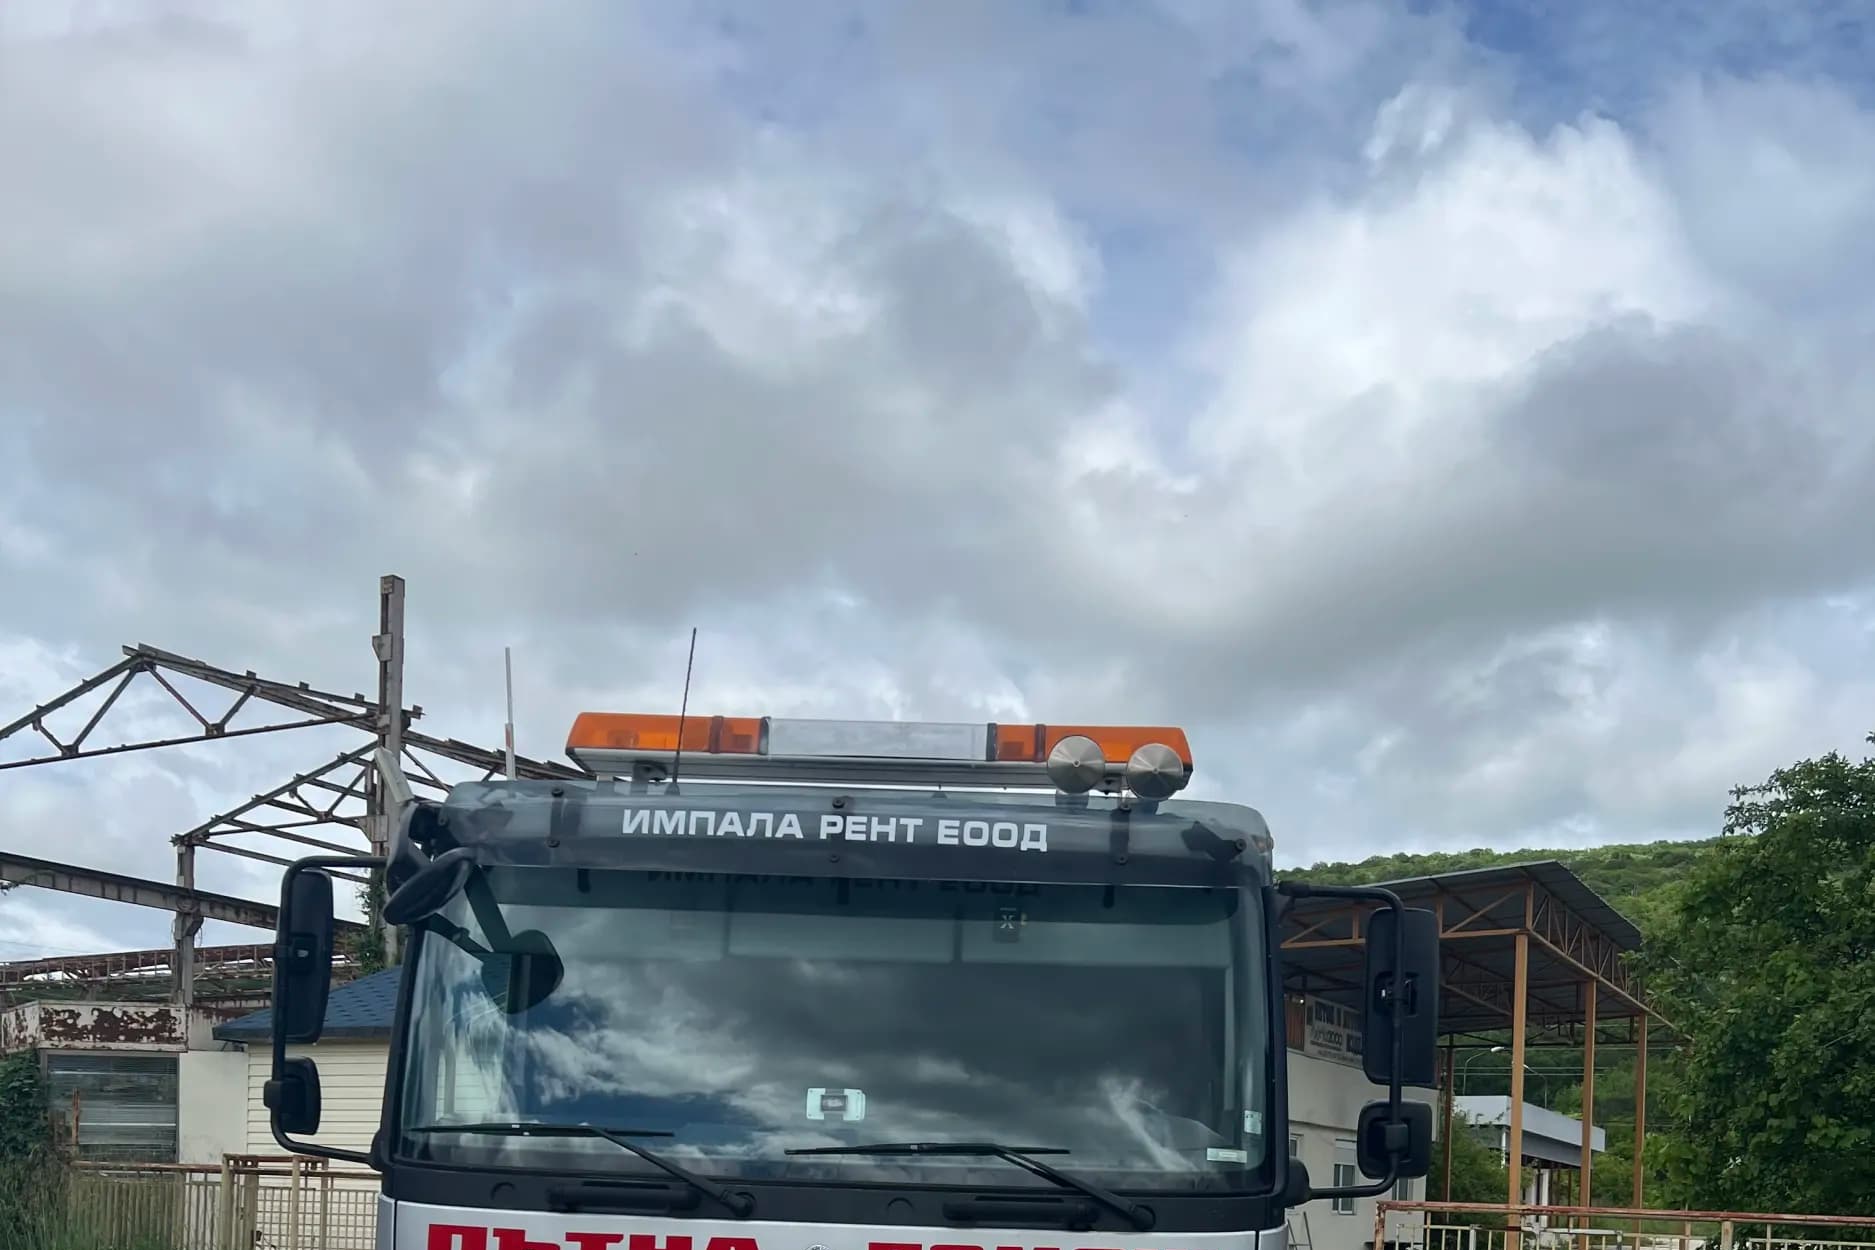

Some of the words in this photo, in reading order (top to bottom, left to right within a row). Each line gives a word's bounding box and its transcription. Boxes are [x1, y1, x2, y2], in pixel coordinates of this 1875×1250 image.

[622, 808, 804, 839] ИМПАЛА
[819, 814, 924, 843] РЕНТ
[937, 819, 1048, 852] ЕООД
